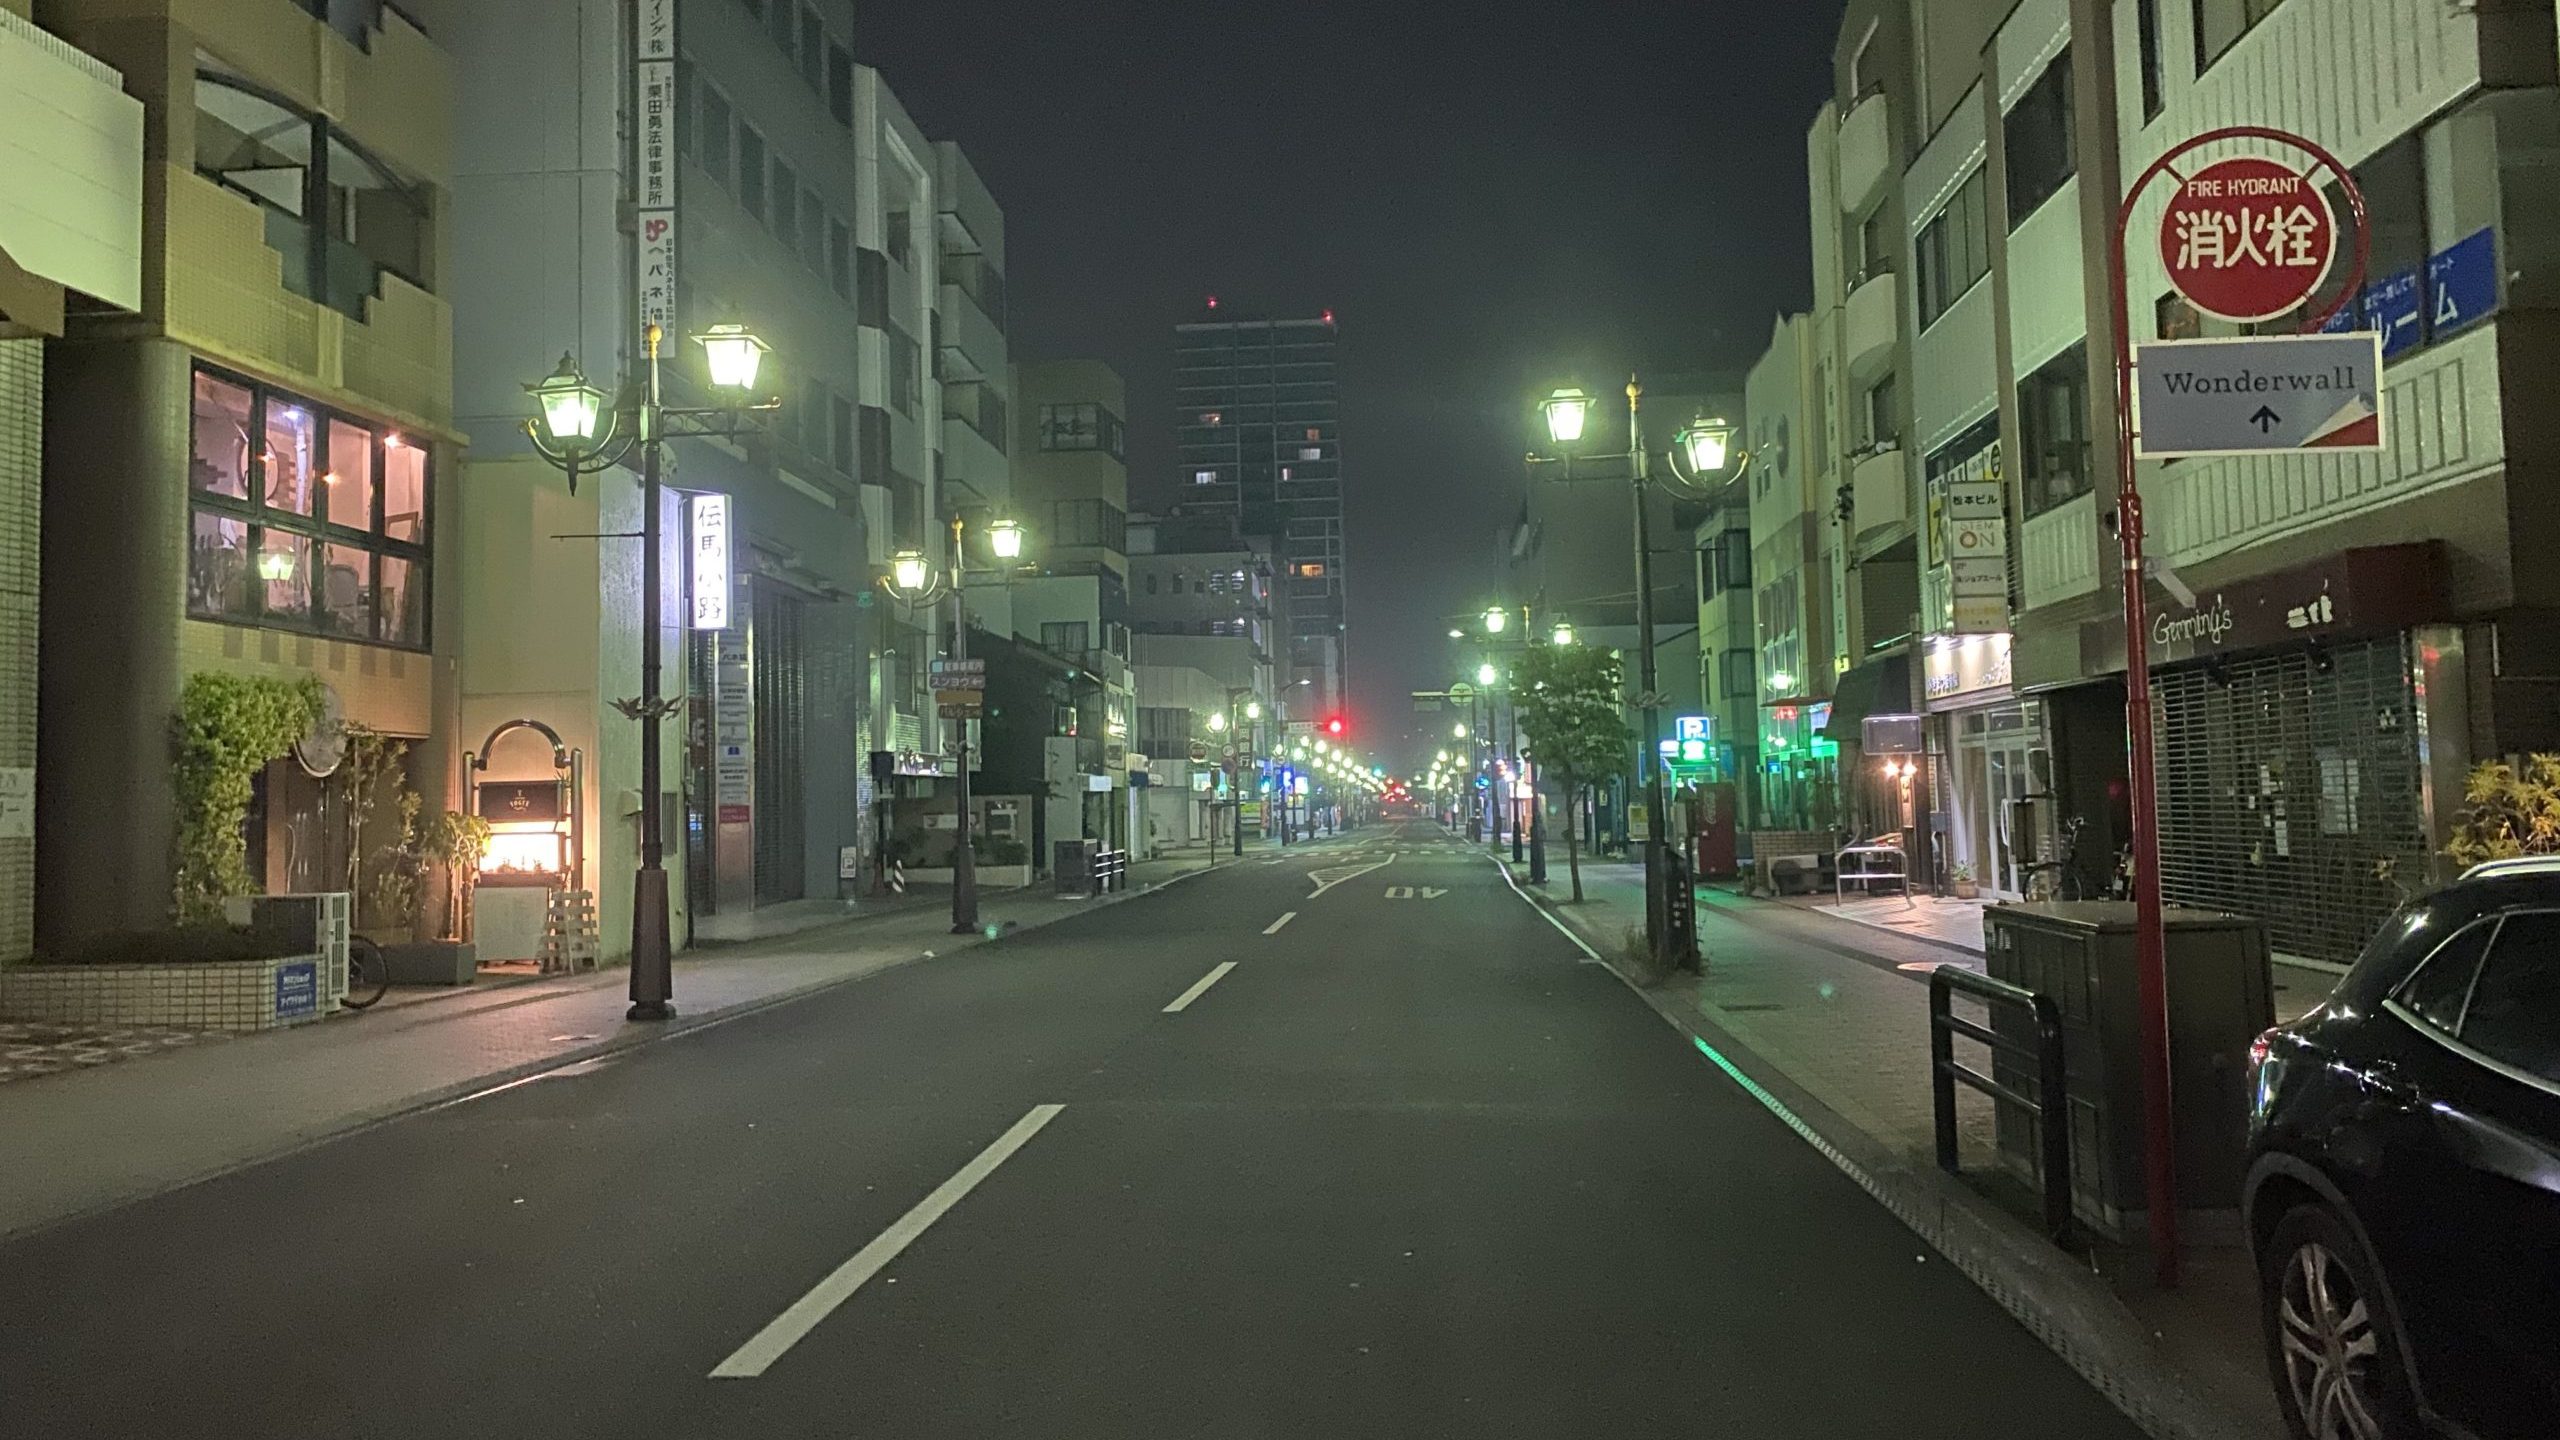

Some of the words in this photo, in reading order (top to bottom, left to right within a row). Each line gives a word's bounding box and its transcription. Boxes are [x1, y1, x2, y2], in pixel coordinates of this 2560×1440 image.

[2187, 180, 2222, 198] FIRE
[2228, 177, 2301, 197] HYDRANT
[2175, 205, 2318, 270] 消火栓
[2161, 366, 2356, 395] Wonderwall
[1952, 495, 1998, 506] 松本ビル
